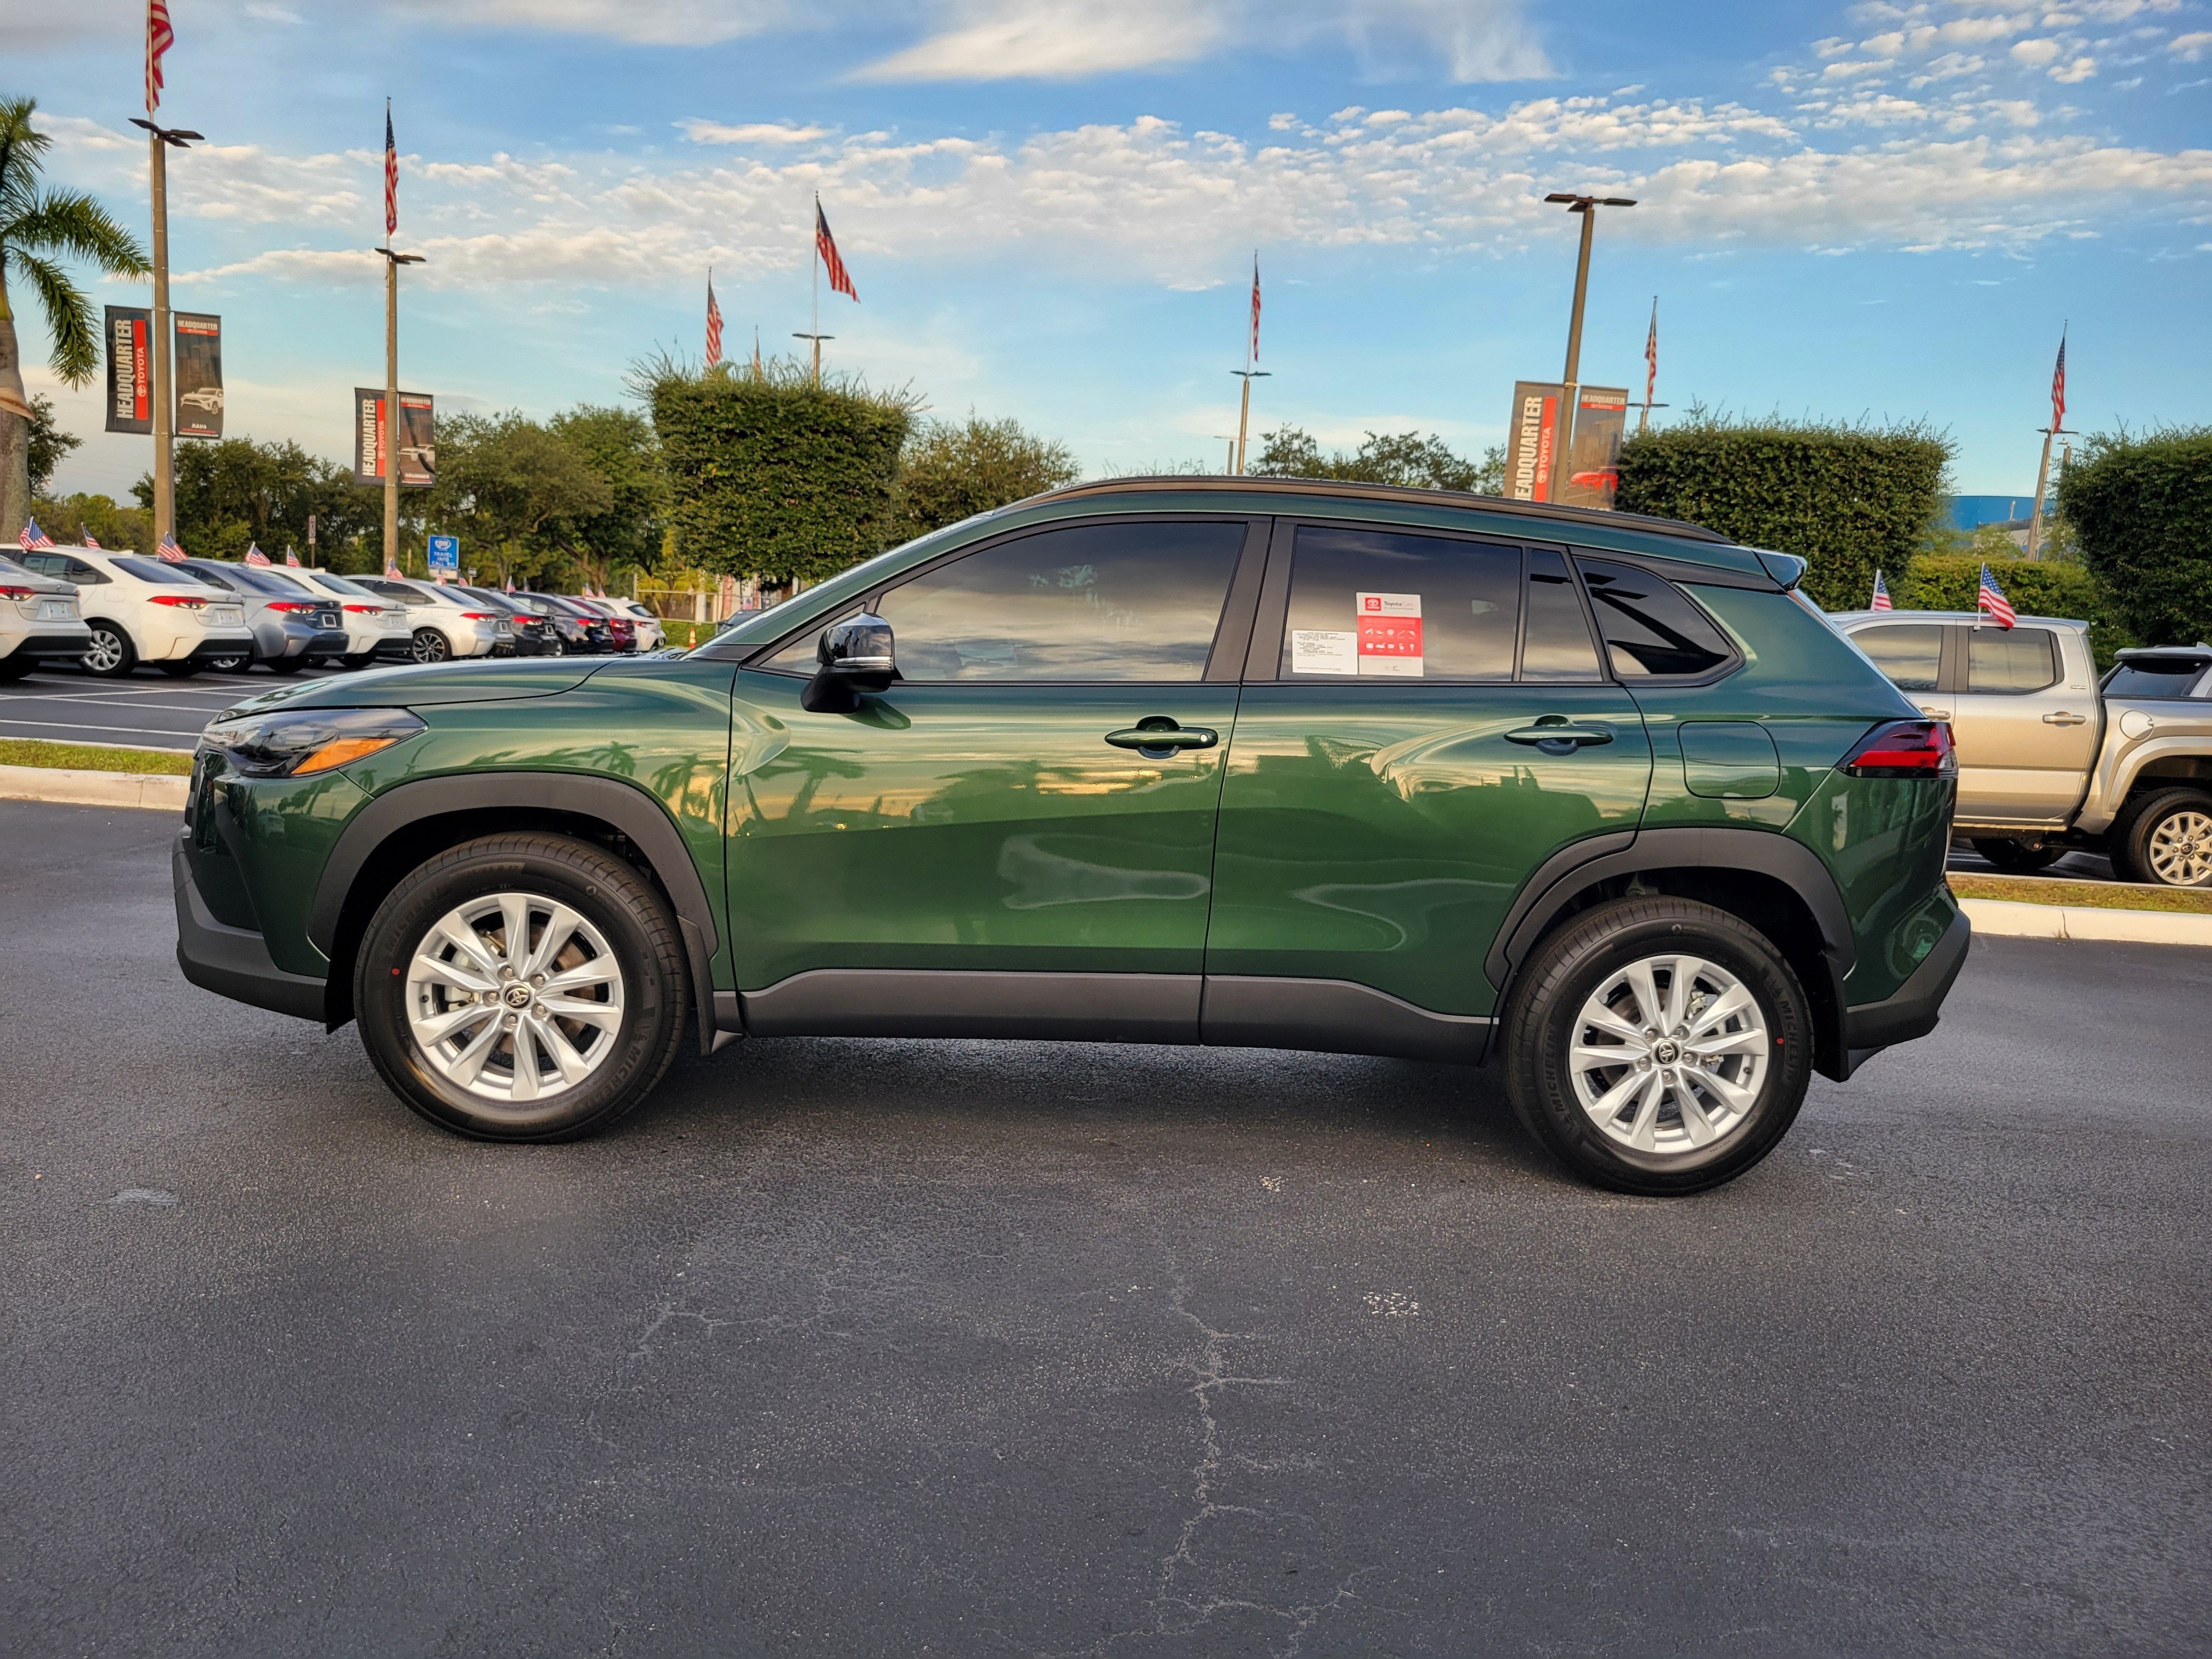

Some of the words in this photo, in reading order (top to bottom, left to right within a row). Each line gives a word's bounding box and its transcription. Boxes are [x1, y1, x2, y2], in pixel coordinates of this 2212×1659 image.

[177, 320, 218, 331] HEADQUARTER
[115, 319, 136, 419] HEADQUARTER
[137, 346, 145, 384] TOYOTA
[1581, 394, 1626, 405] HEADQUARTER
[362, 398, 378, 477] HEADQUARTER
[1538, 426, 1552, 471] TOYOTA
[1544, 1023, 1566, 1113] MICHELIN
